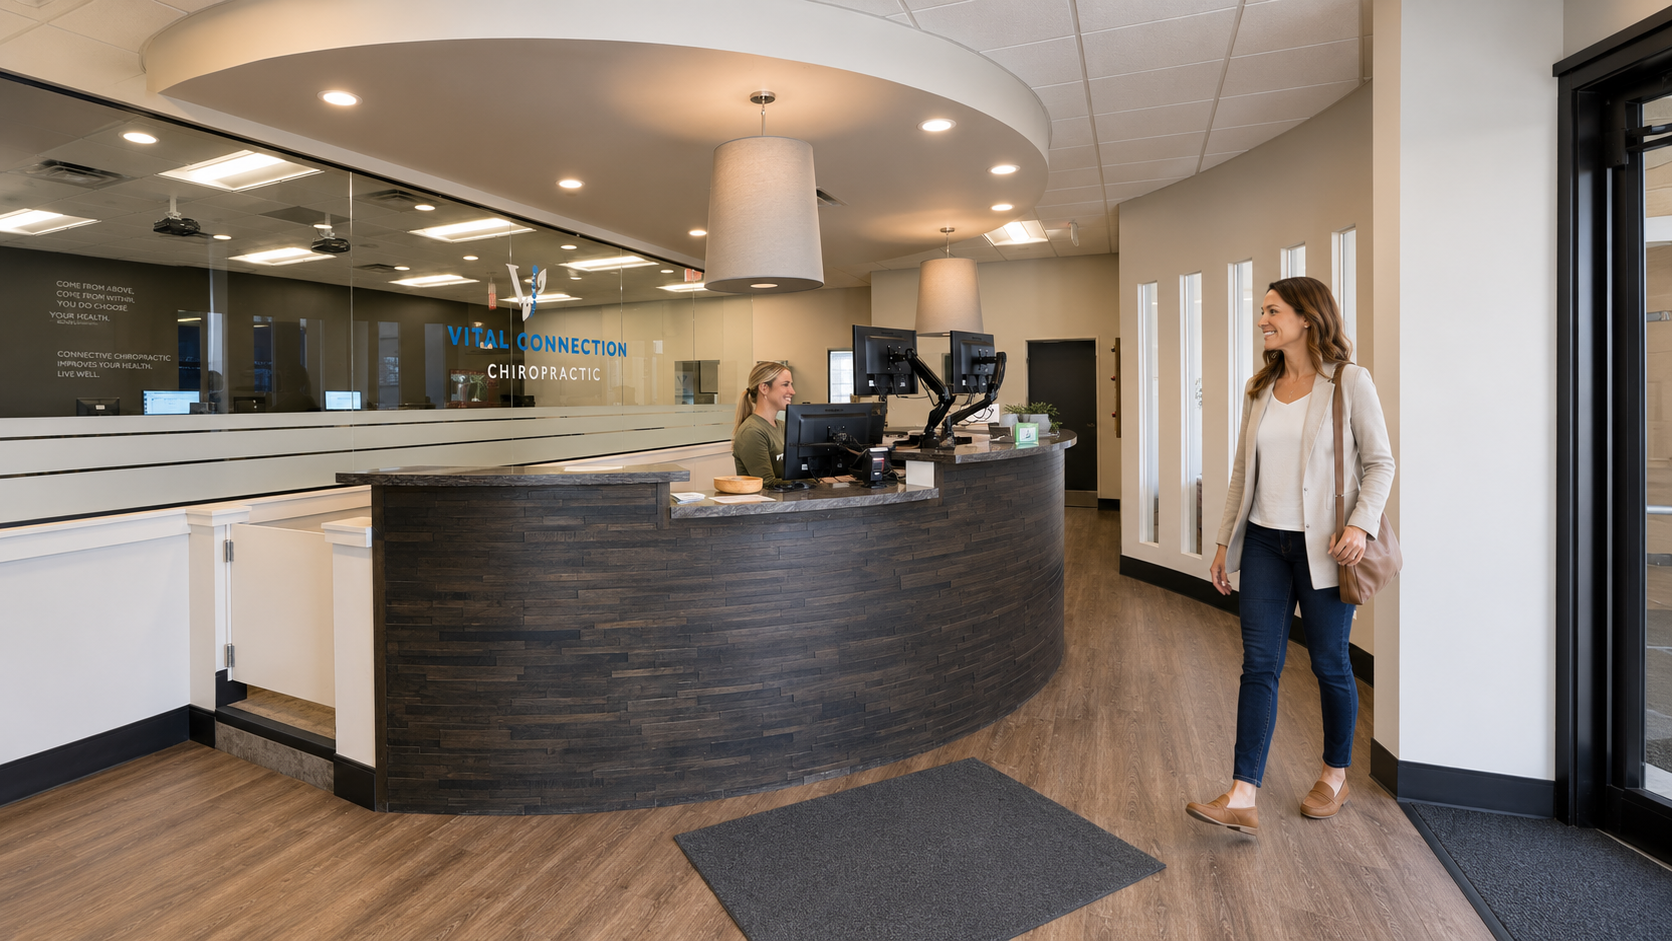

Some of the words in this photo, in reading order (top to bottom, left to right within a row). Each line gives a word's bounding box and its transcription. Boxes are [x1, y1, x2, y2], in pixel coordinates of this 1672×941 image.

[56, 280, 81, 289] COME
[82, 283, 105, 291] FROM
[56, 300, 76, 308] YOU
[49, 311, 75, 319] YOUR
[447, 325, 509, 350] VITAL
[516, 332, 627, 358] CONNECTION
[57, 350, 112, 360] CONNECTIVE
[57, 360, 97, 368] IMPROVES
[99, 361, 121, 369] YOUR
[122, 362, 153, 370] HEALTH.
[76, 370, 100, 378] WELL.
[487, 363, 601, 382] CHIROPRACTIC
